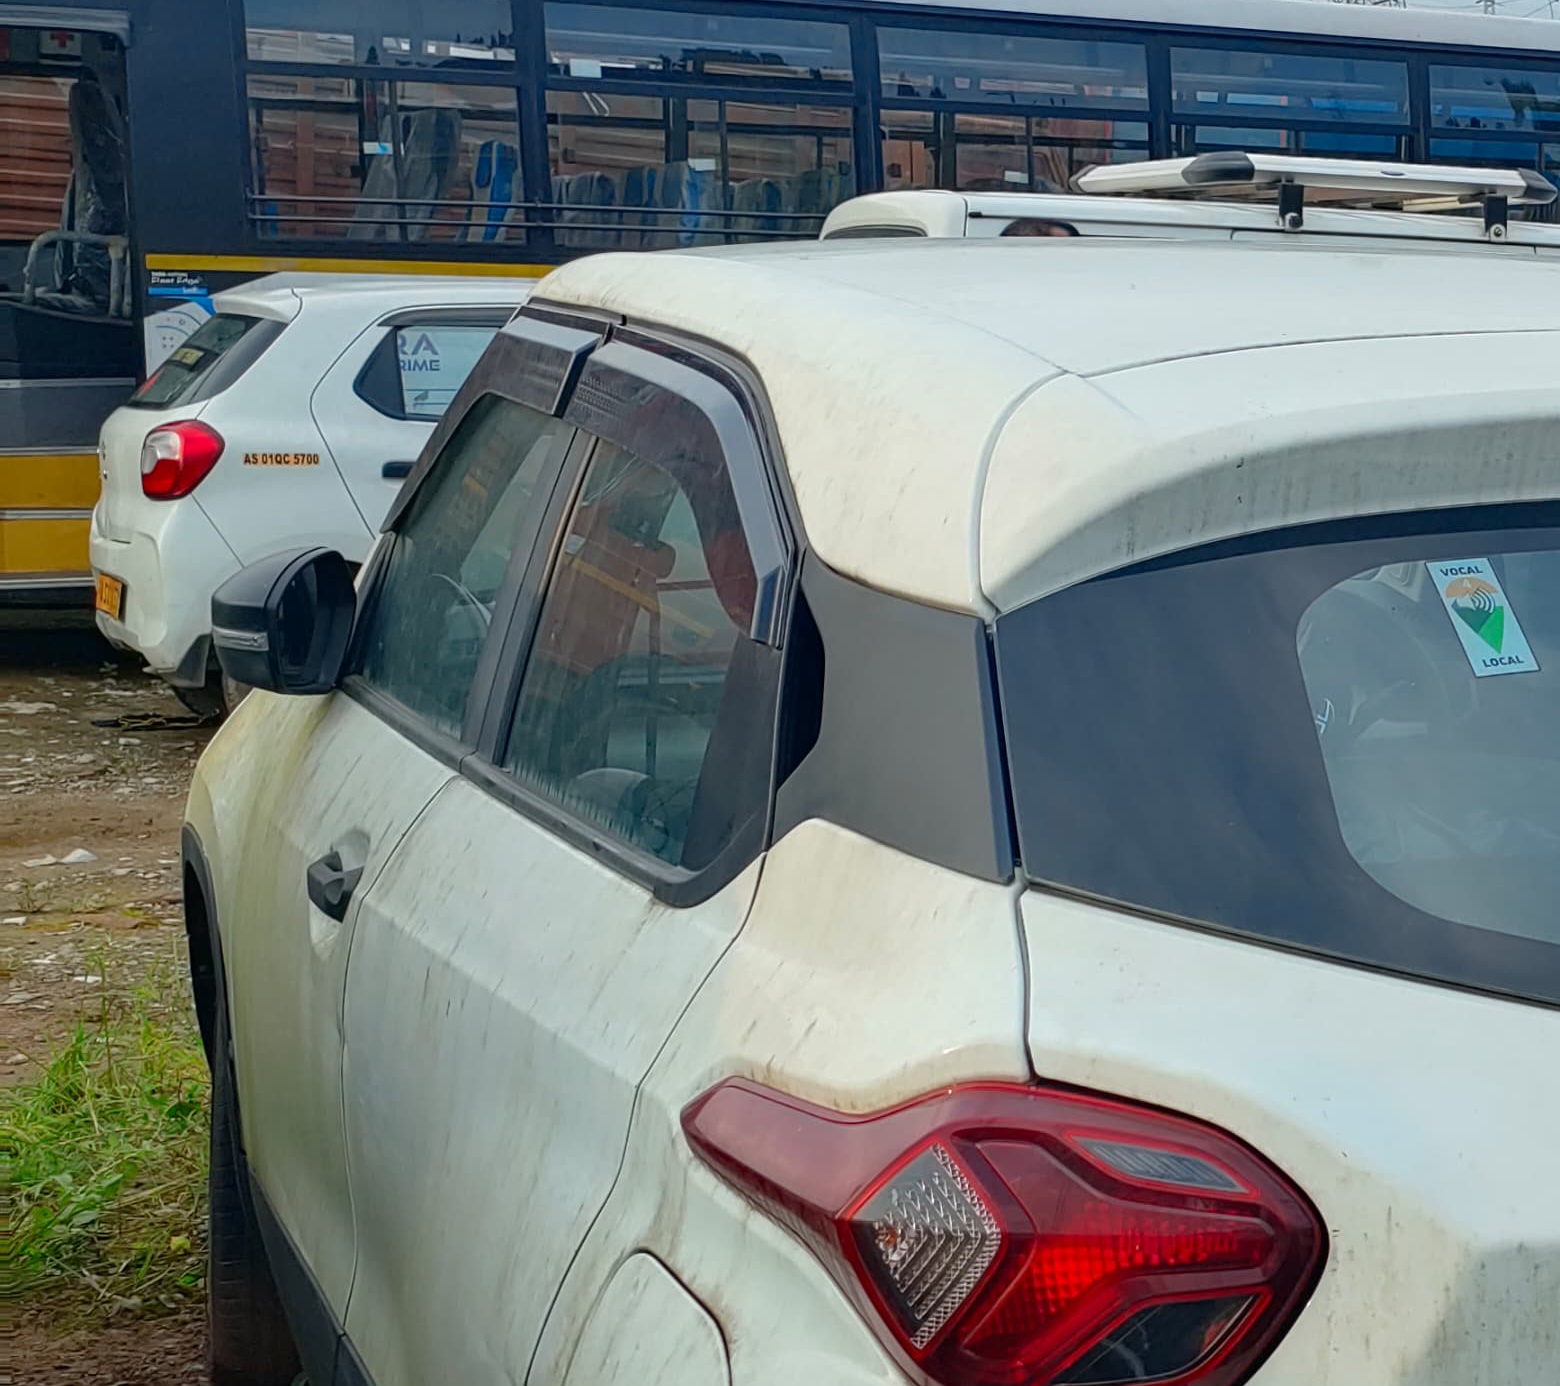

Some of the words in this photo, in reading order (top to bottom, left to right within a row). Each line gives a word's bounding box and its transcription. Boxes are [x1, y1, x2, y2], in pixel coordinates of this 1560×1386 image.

[243, 453, 258, 465] AS
[261, 453, 290, 465] 01QC
[294, 453, 319, 465] 5700
[1440, 565, 1483, 577] VOCAL
[1481, 655, 1524, 668] LOCAL
